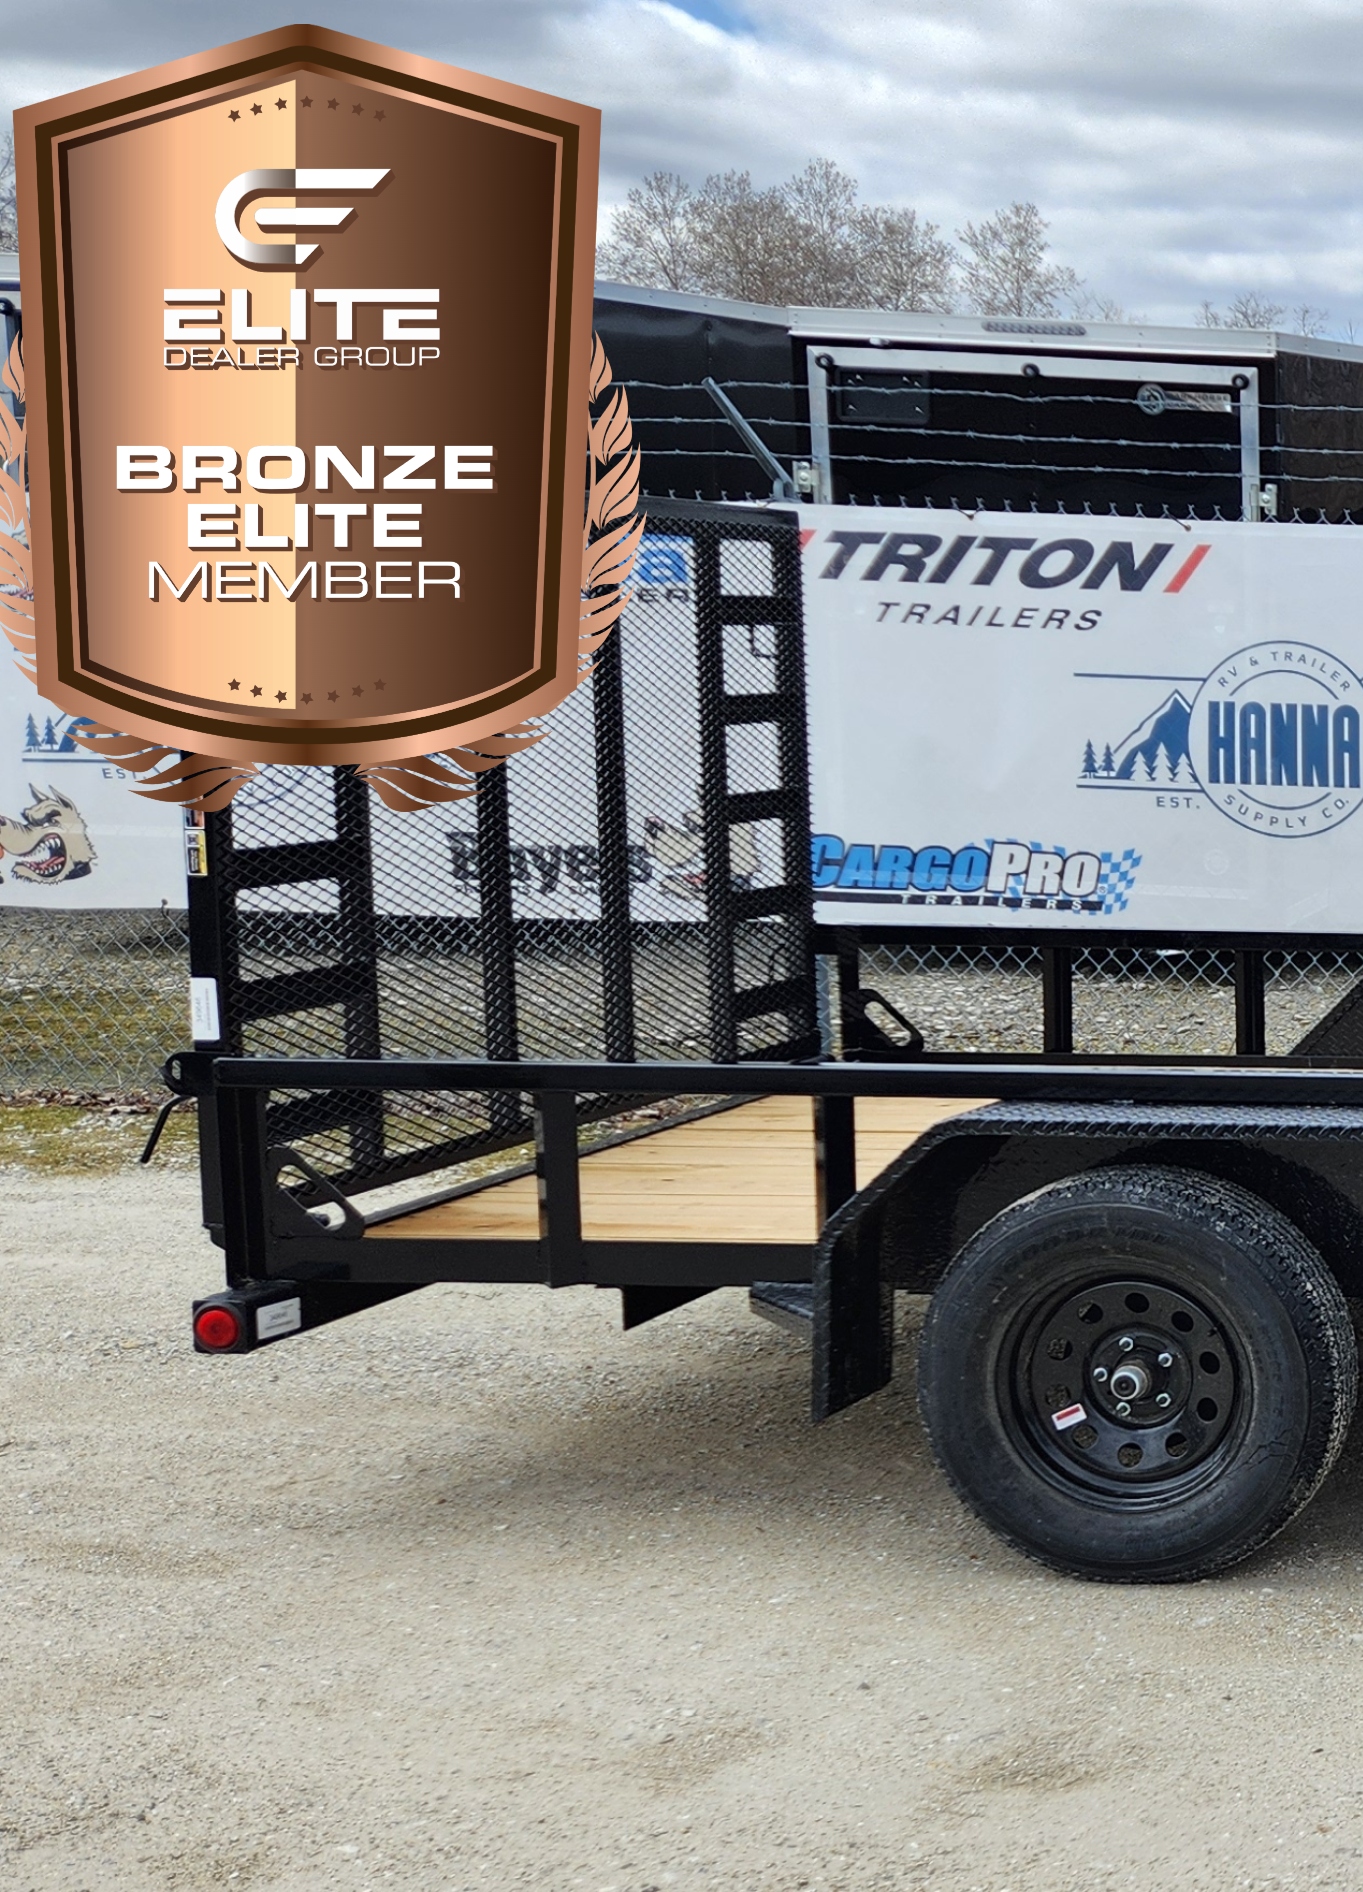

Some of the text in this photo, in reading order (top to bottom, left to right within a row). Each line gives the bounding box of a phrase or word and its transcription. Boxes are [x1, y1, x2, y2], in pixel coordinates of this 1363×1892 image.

[818, 530, 1174, 592] TRITON
[876, 601, 1103, 632] TRAILERS
[1217, 651, 1351, 692] RV & TRAILER
[1208, 701, 1361, 788] HANNA
[1156, 796, 1201, 809] EST.
[1223, 794, 1308, 828] SUPPLY
[900, 893, 1084, 911] TRAILERS
